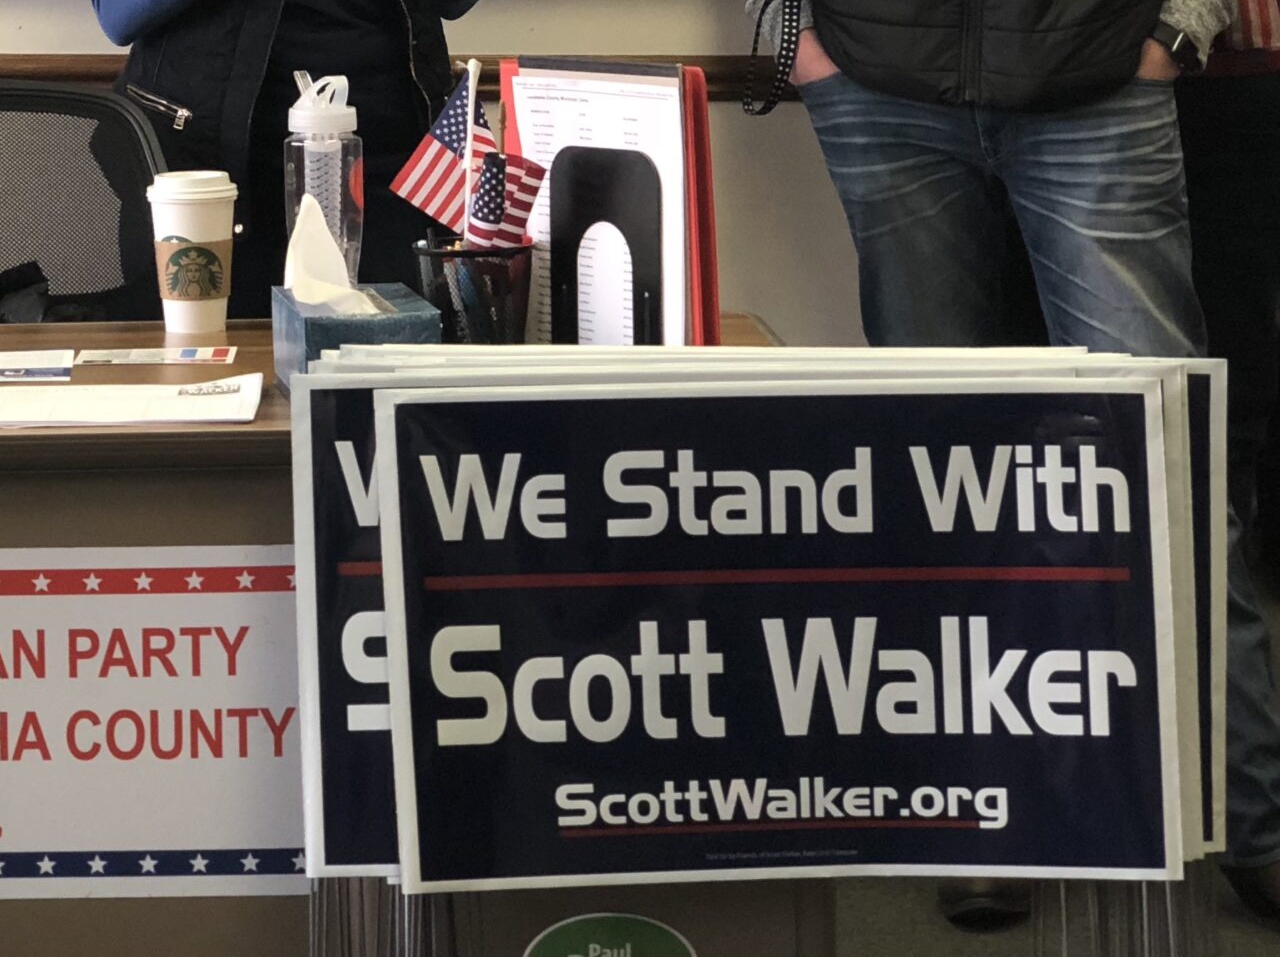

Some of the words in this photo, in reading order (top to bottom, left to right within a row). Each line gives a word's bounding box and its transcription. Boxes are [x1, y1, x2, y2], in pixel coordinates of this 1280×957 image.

[419, 452, 568, 543] We
[602, 446, 873, 539] Stand
[909, 444, 1132, 535] With
[67, 626, 251, 679] PARTY
[430, 619, 726, 748] Scott
[759, 615, 1138, 738] Walker
[65, 706, 297, 762] COUNTY
[554, 774, 1010, 831] ScottWalker.org
